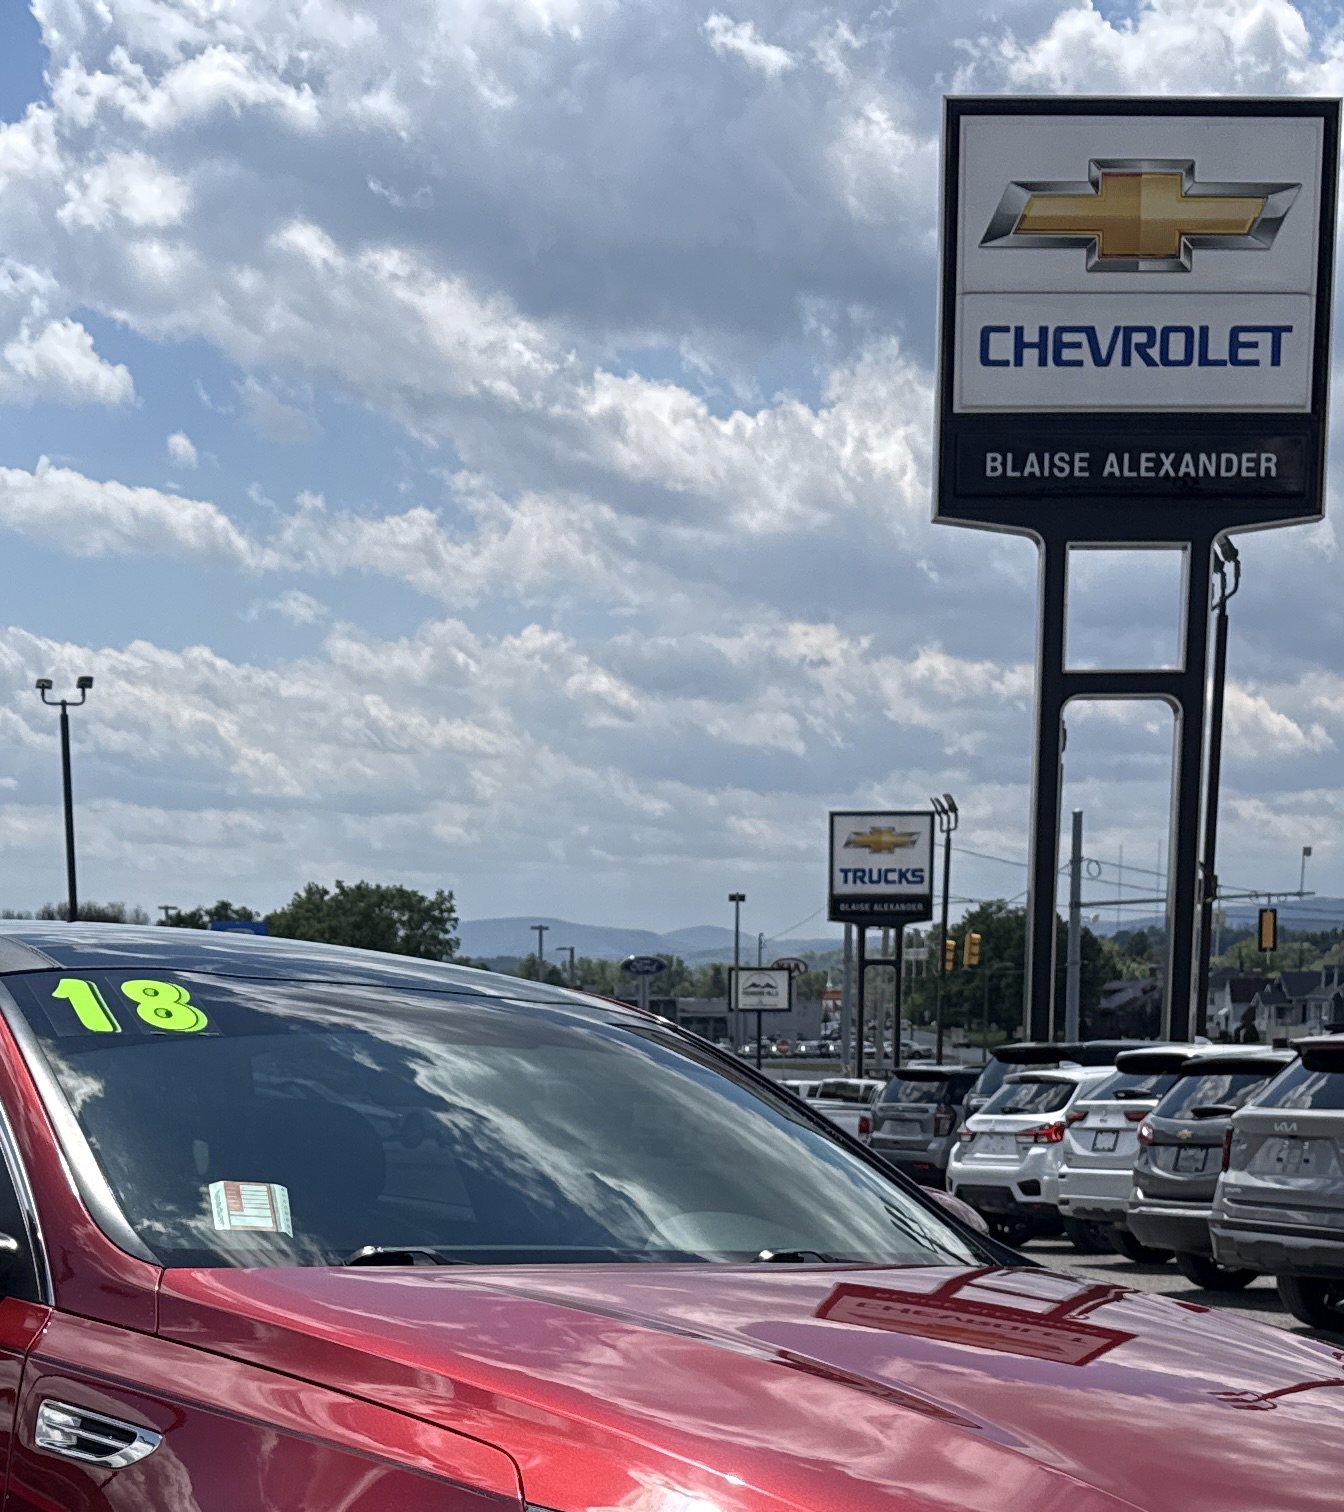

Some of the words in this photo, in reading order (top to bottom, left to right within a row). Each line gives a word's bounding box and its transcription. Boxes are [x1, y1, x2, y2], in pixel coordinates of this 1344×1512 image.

[979, 325, 1293, 368] CHEVROLET
[985, 452, 1090, 478] BLAISE
[1102, 452, 1278, 478] ALEXANDER
[839, 868, 925, 885] TRUCKS
[873, 903, 924, 911] ALEXANDER
[52, 978, 208, 1033] 18
